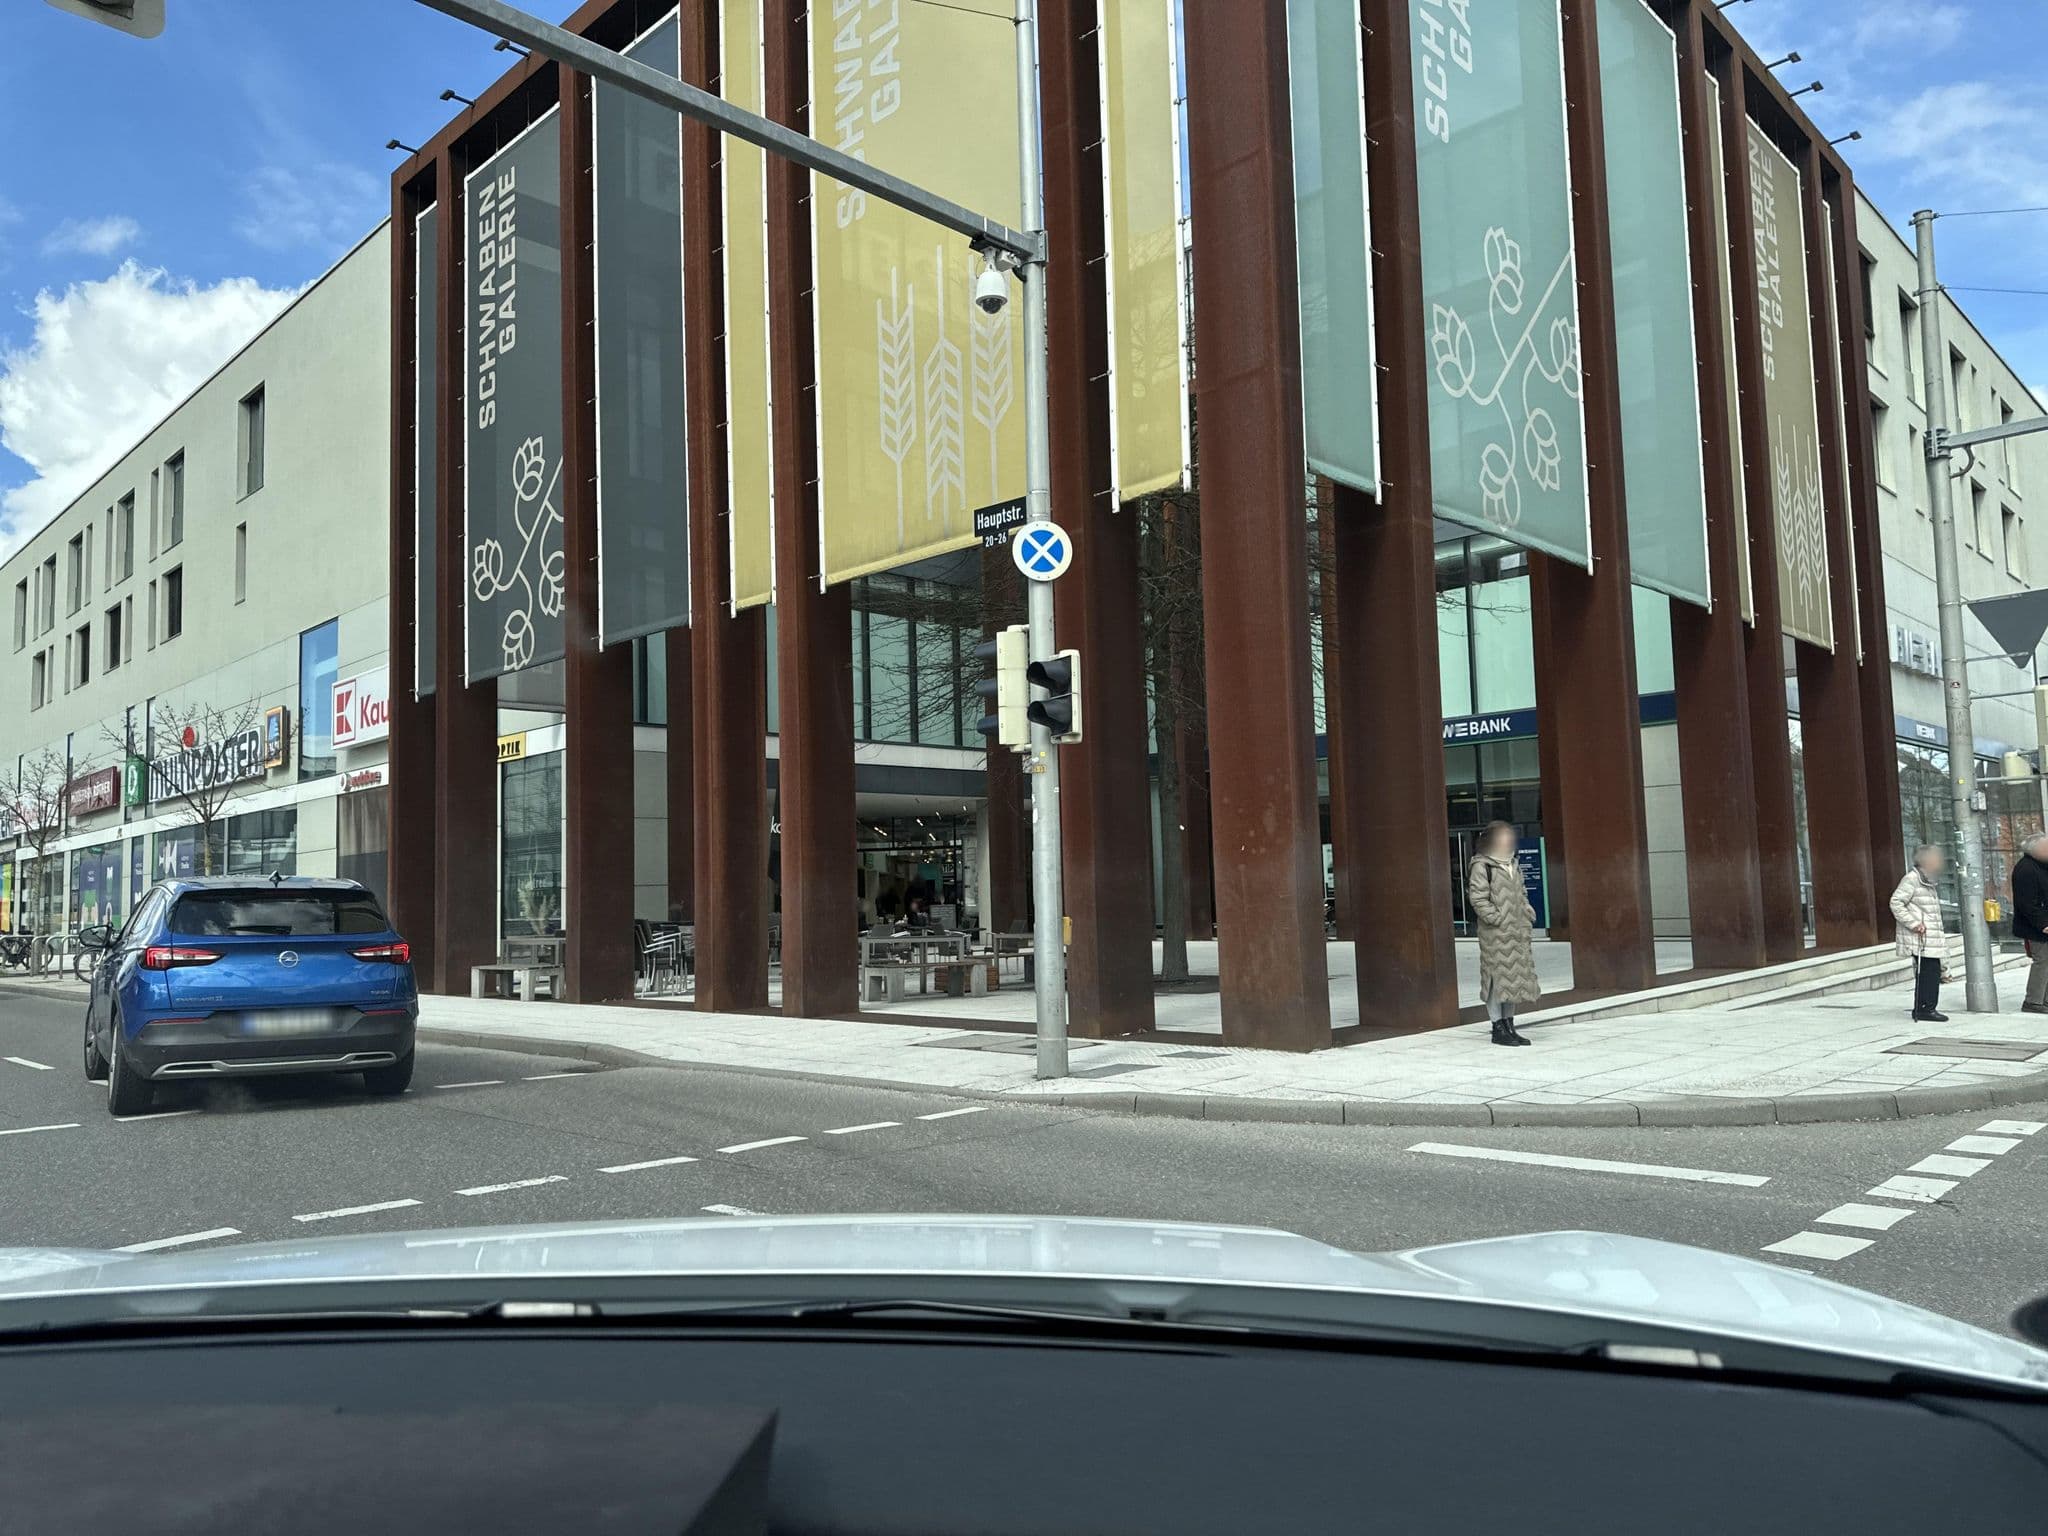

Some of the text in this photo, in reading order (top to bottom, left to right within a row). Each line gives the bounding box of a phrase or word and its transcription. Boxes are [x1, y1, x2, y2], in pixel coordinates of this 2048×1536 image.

[833, 0, 867, 229] SHWA
[869, 0, 901, 123] GAL
[1420, 0, 1449, 143] SCH
[479, 181, 496, 430] SCHWABEN
[499, 166, 516, 355] GALERIE
[1749, 135, 1776, 381] SCHWABEN
[1761, 149, 1783, 329] GALERIE
[977, 506, 1024, 530] Hauptstr.
[985, 532, 1007, 548] 20-26
